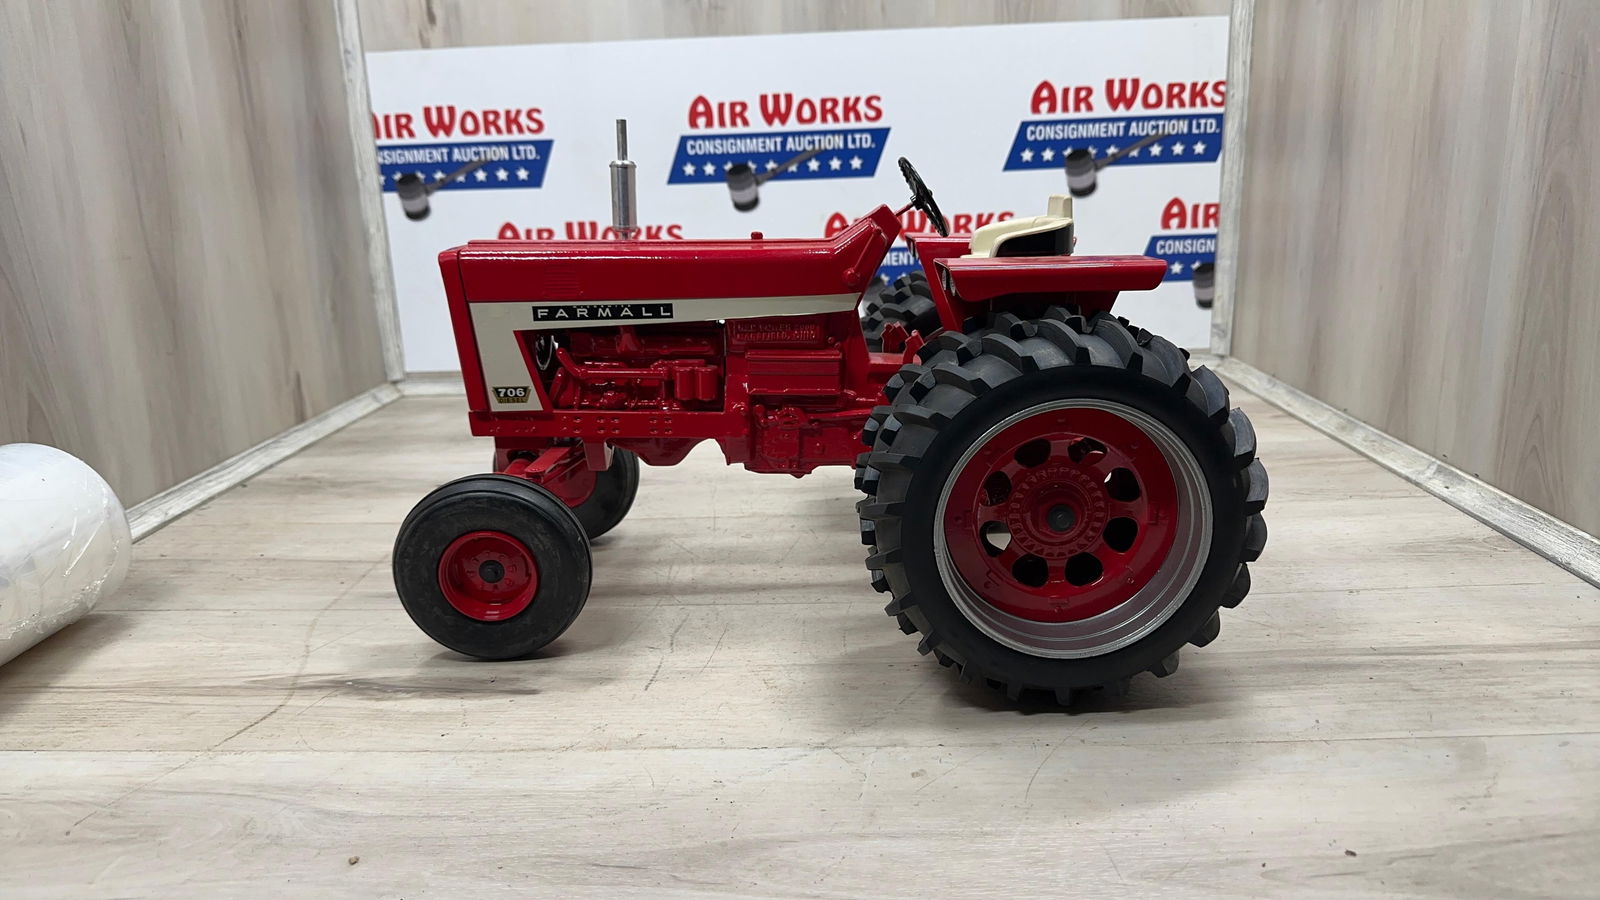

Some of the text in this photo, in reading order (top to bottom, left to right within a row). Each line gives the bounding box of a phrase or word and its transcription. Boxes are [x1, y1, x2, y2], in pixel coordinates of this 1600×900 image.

[1031, 78, 1226, 114] AIR WORKS
[423, 105, 545, 137] WORKS
[688, 93, 883, 129] AIR WORKS
[1026, 118, 1221, 141] CONSIGNMENT AUCTION LTD.
[452, 145, 509, 162] AUCTION
[511, 144, 541, 160] LTD.
[686, 133, 876, 155] CONSIGNMENT AUCTION LTD.
[1161, 197, 1220, 229] AIR
[537, 306, 671, 319] FARMALL
[497, 388, 526, 398] 706
